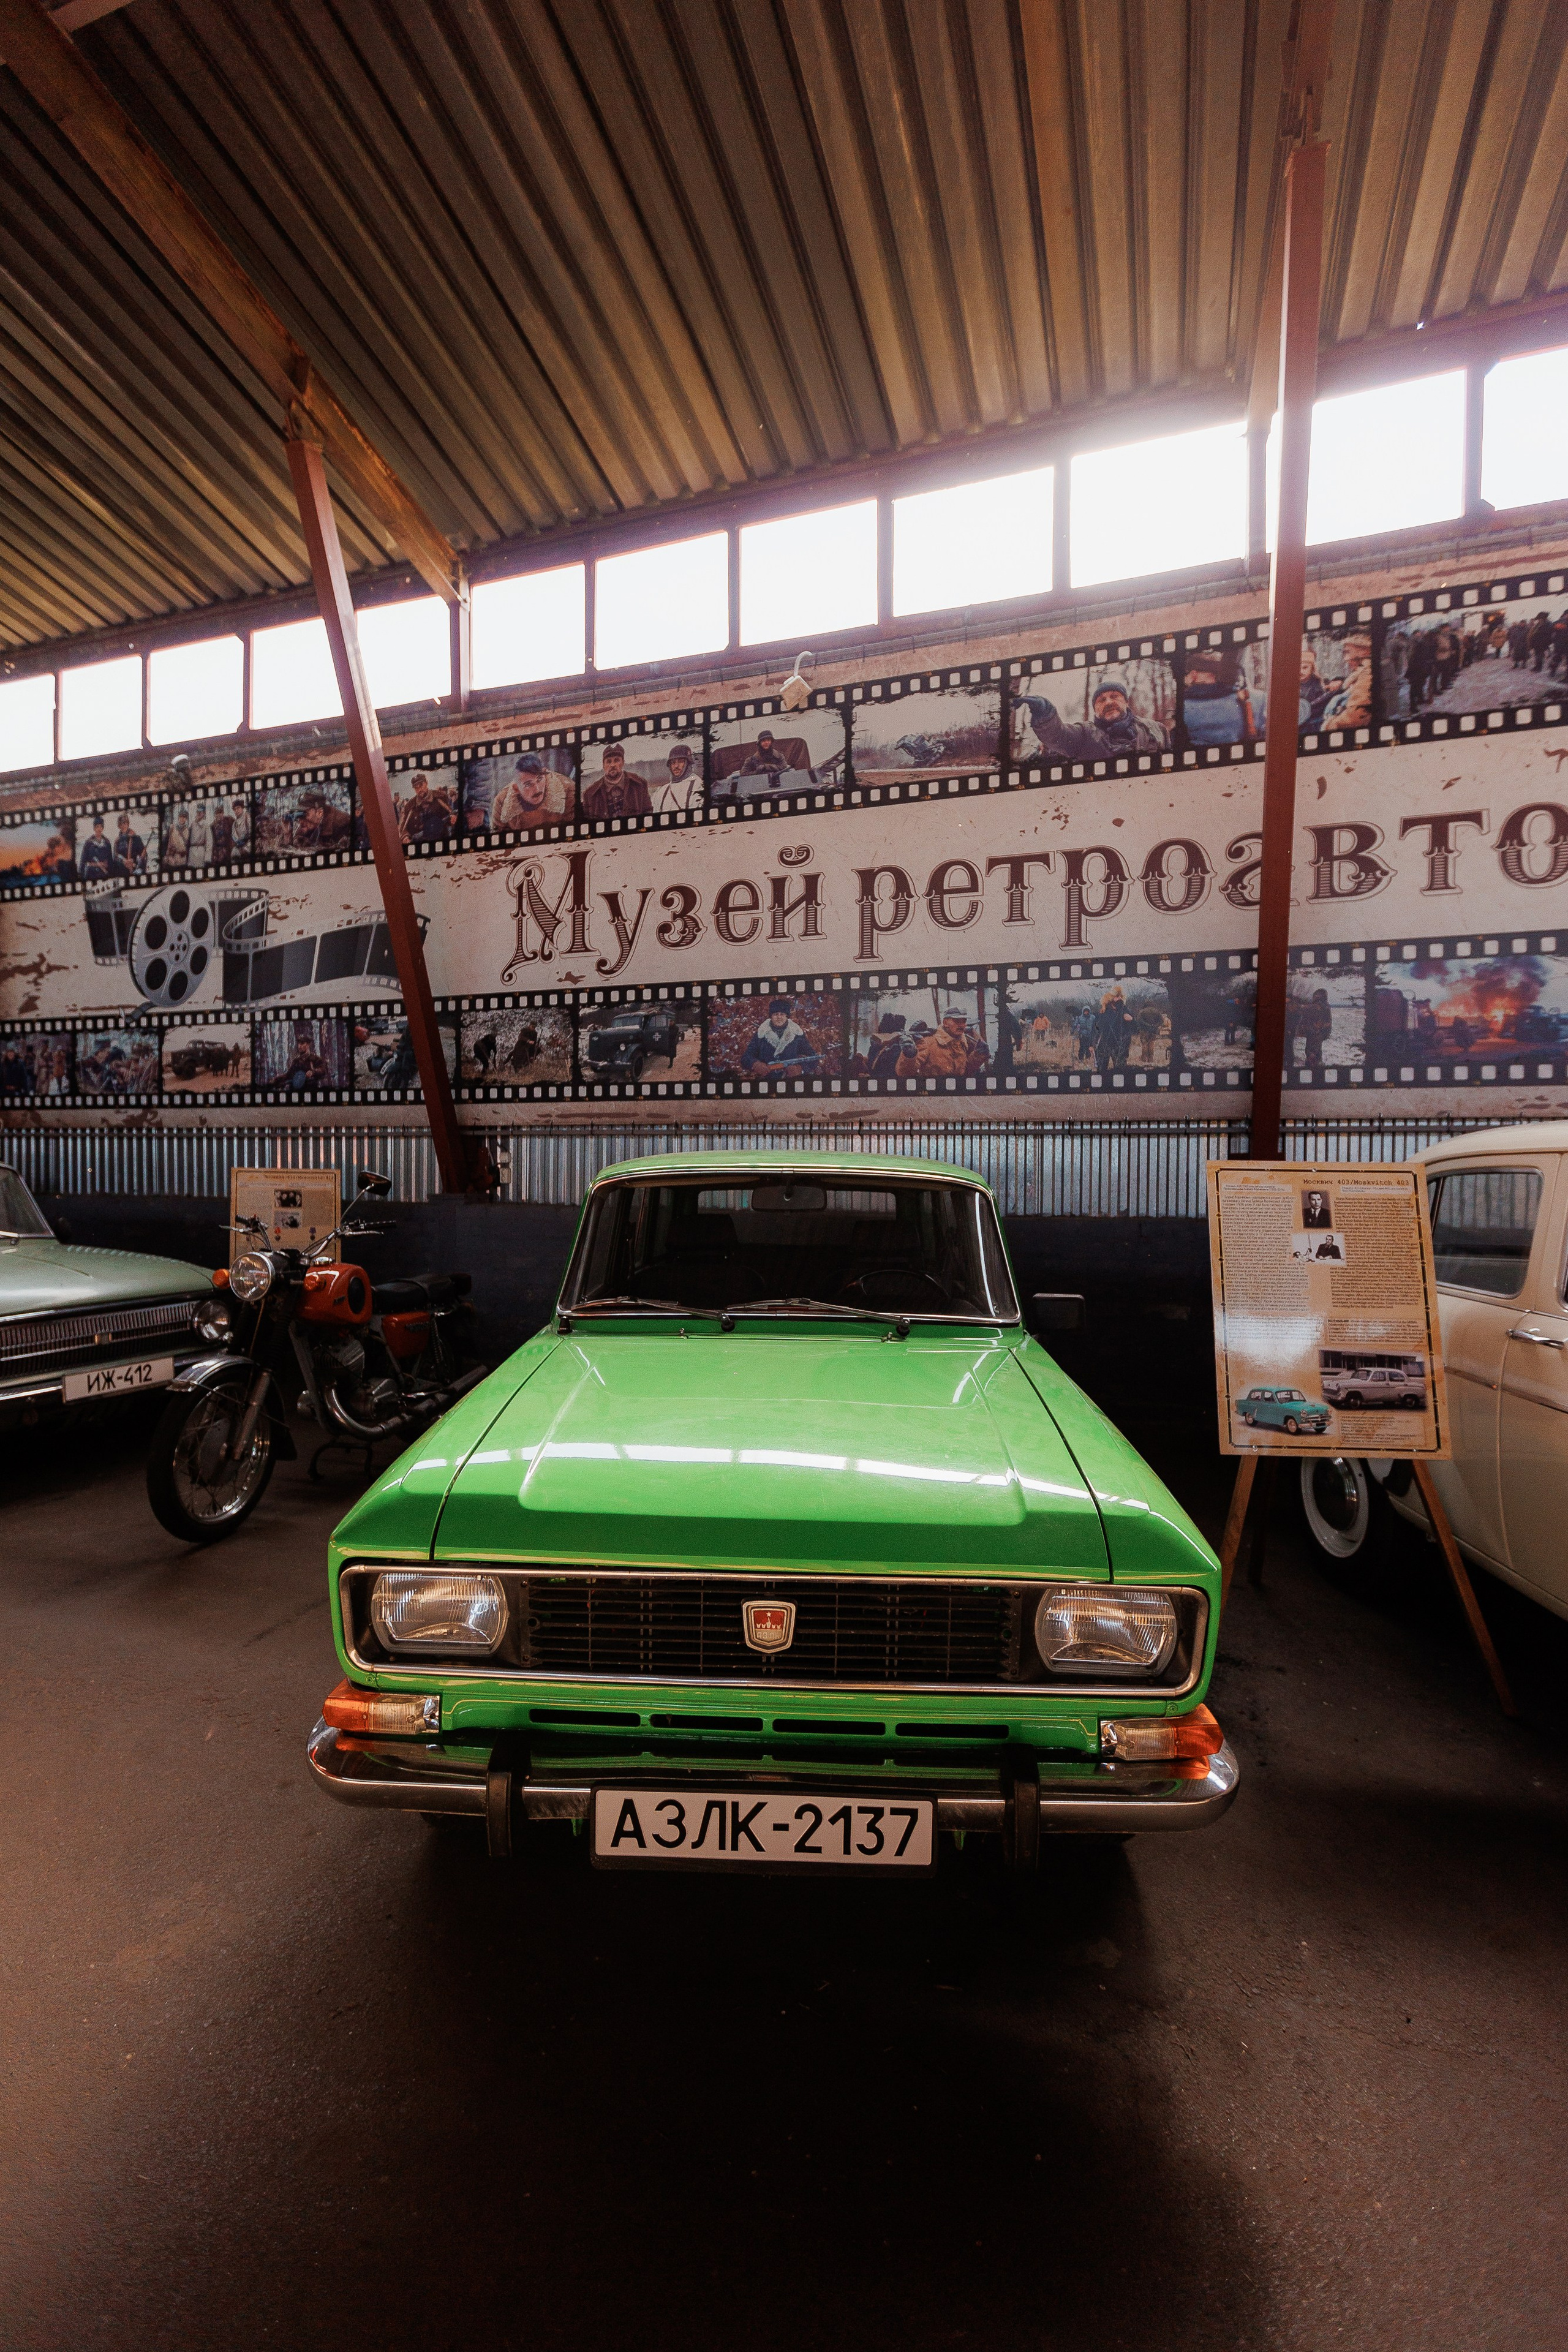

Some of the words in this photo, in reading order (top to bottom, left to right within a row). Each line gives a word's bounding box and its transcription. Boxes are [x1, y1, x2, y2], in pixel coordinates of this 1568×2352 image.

[500, 844, 827, 986] Музей
[87, 1363, 153, 1393] ИЖ-412
[610, 1798, 919, 1856] АЗЛК-2137
